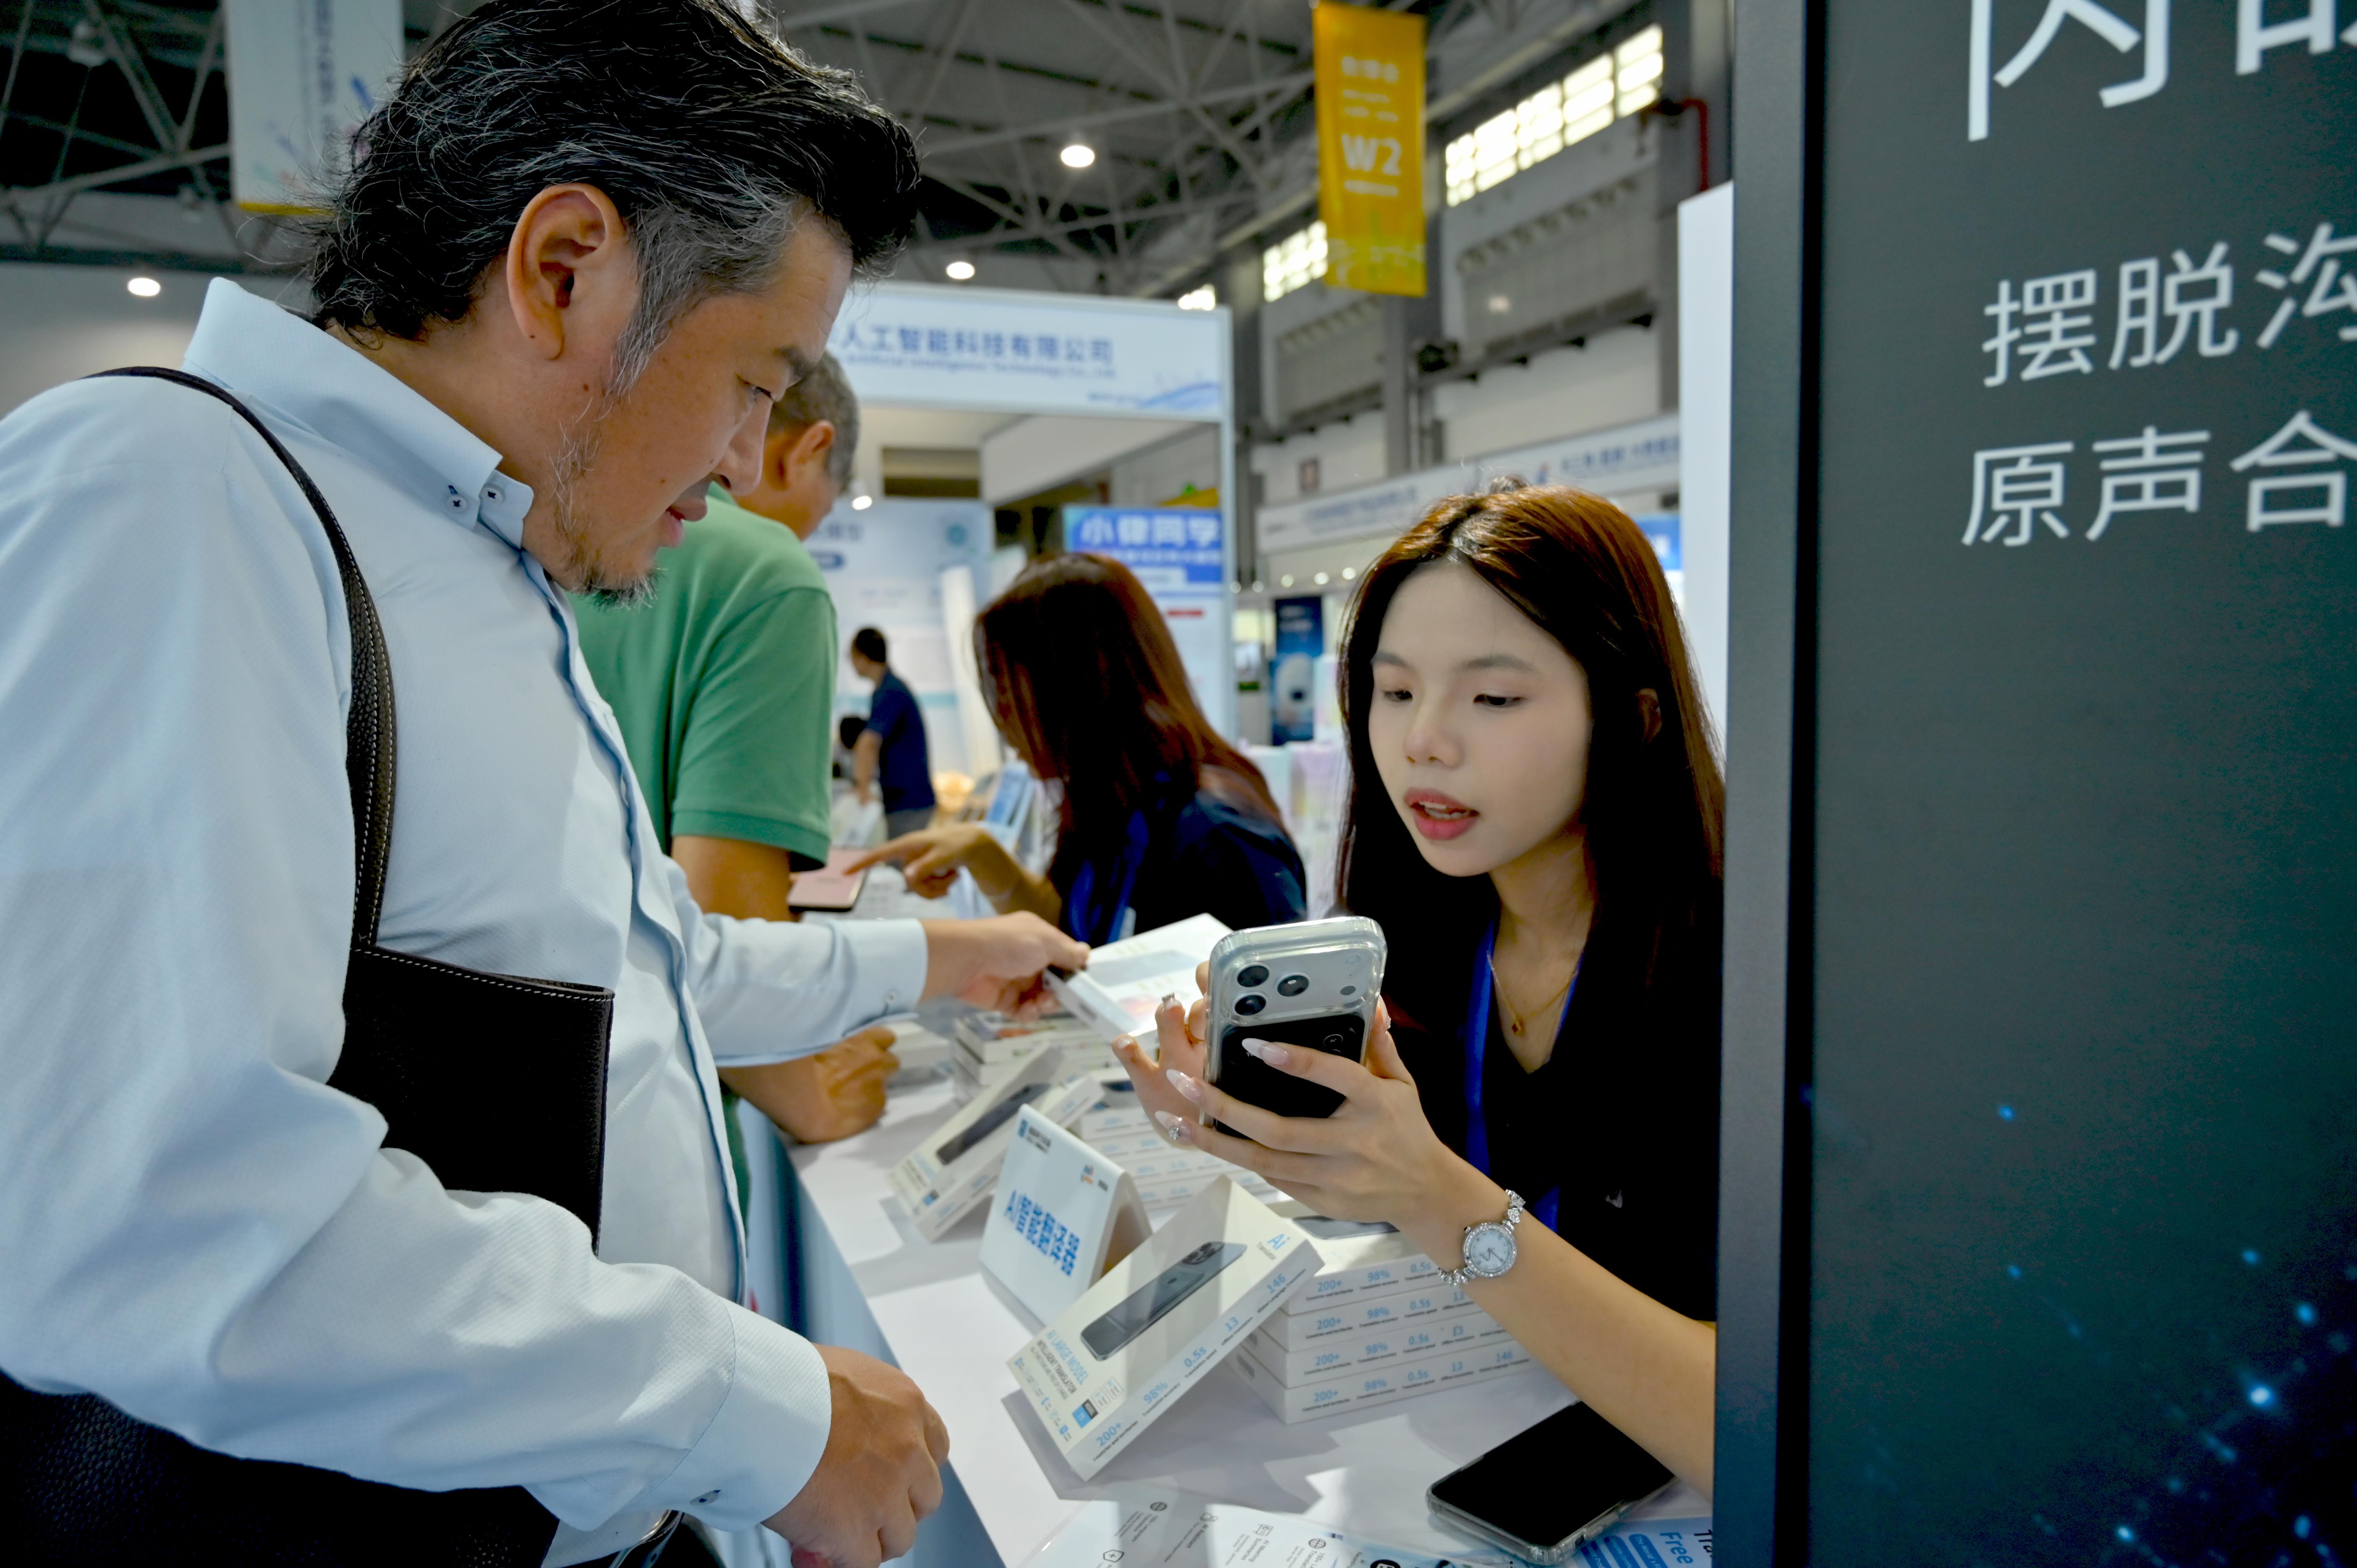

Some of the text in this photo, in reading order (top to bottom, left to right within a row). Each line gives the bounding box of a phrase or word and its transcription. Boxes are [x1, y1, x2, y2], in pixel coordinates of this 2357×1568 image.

[1341, 133, 1402, 176] W2
[1962, 409, 2357, 546] 原声合
[1256, 1241, 1277, 1261] Translator
[1267, 1233, 1291, 1250] Ai
[1266, 1273, 1286, 1294] 146
[1317, 1261, 1432, 1292] 200+ 98% 0.5s
[1224, 1317, 1239, 1331] 13
[1316, 1317, 1341, 1330] 200+
[1367, 1307, 1390, 1319] 98%
[1410, 1298, 1431, 1310] 0.5s
[1184, 1346, 1207, 1368] 0.5s
[1315, 1353, 1339, 1366] 200+
[1366, 1342, 1388, 1355] 98%
[1408, 1333, 1429, 1345] 0.5s
[1314, 1350, 1513, 1402] 200+ 98% 0.5s 13 146
[1143, 1381, 1168, 1404] 98%
[1096, 1422, 1122, 1447] 200+
[1659, 1532, 1693, 1564] Free
